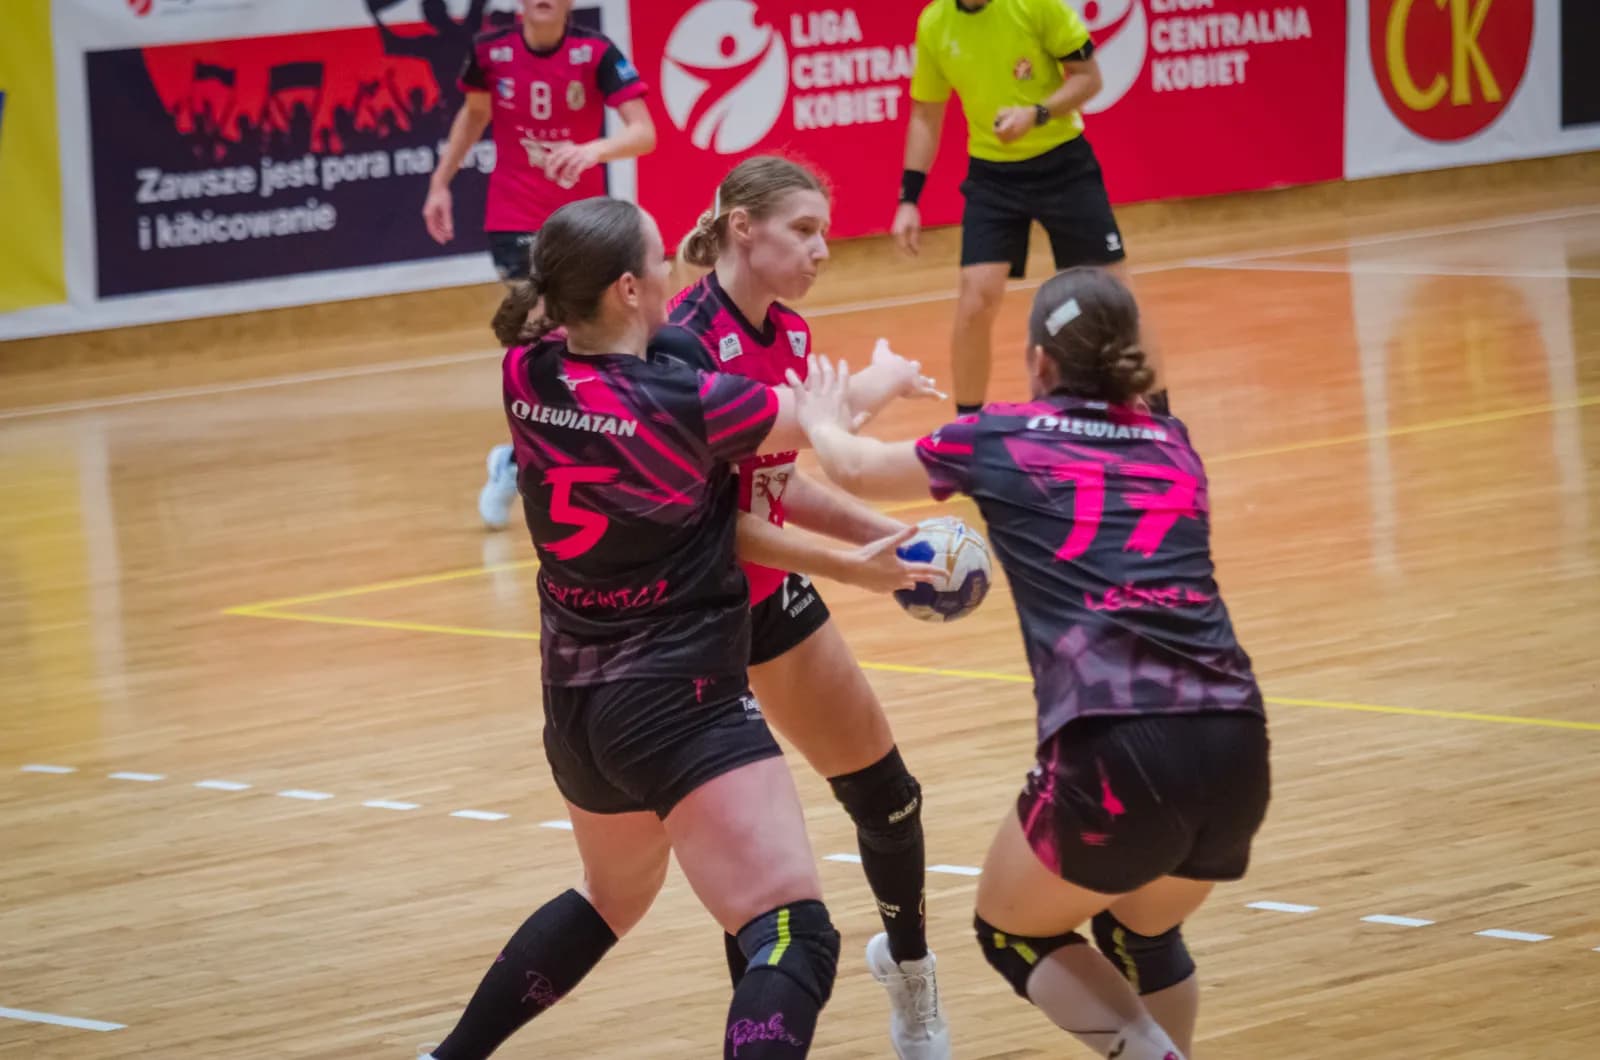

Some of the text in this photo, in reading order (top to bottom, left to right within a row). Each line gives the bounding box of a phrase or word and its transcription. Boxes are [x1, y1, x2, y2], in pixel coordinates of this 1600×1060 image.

[790, 8, 863, 48] LIGA
[1151, 6, 1312, 53] CENTRALNA
[1152, 50, 1250, 93] KOBIET
[530, 81, 552, 120] 8
[793, 85, 902, 130] KOBIET
[136, 167, 257, 203] Zawsze
[260, 156, 319, 197] jest
[321, 151, 390, 191] pora
[393, 146, 434, 176] na
[138, 196, 337, 251] i kibicowanie
[530, 404, 638, 437] LEWIATAN
[541, 466, 620, 561] 5
